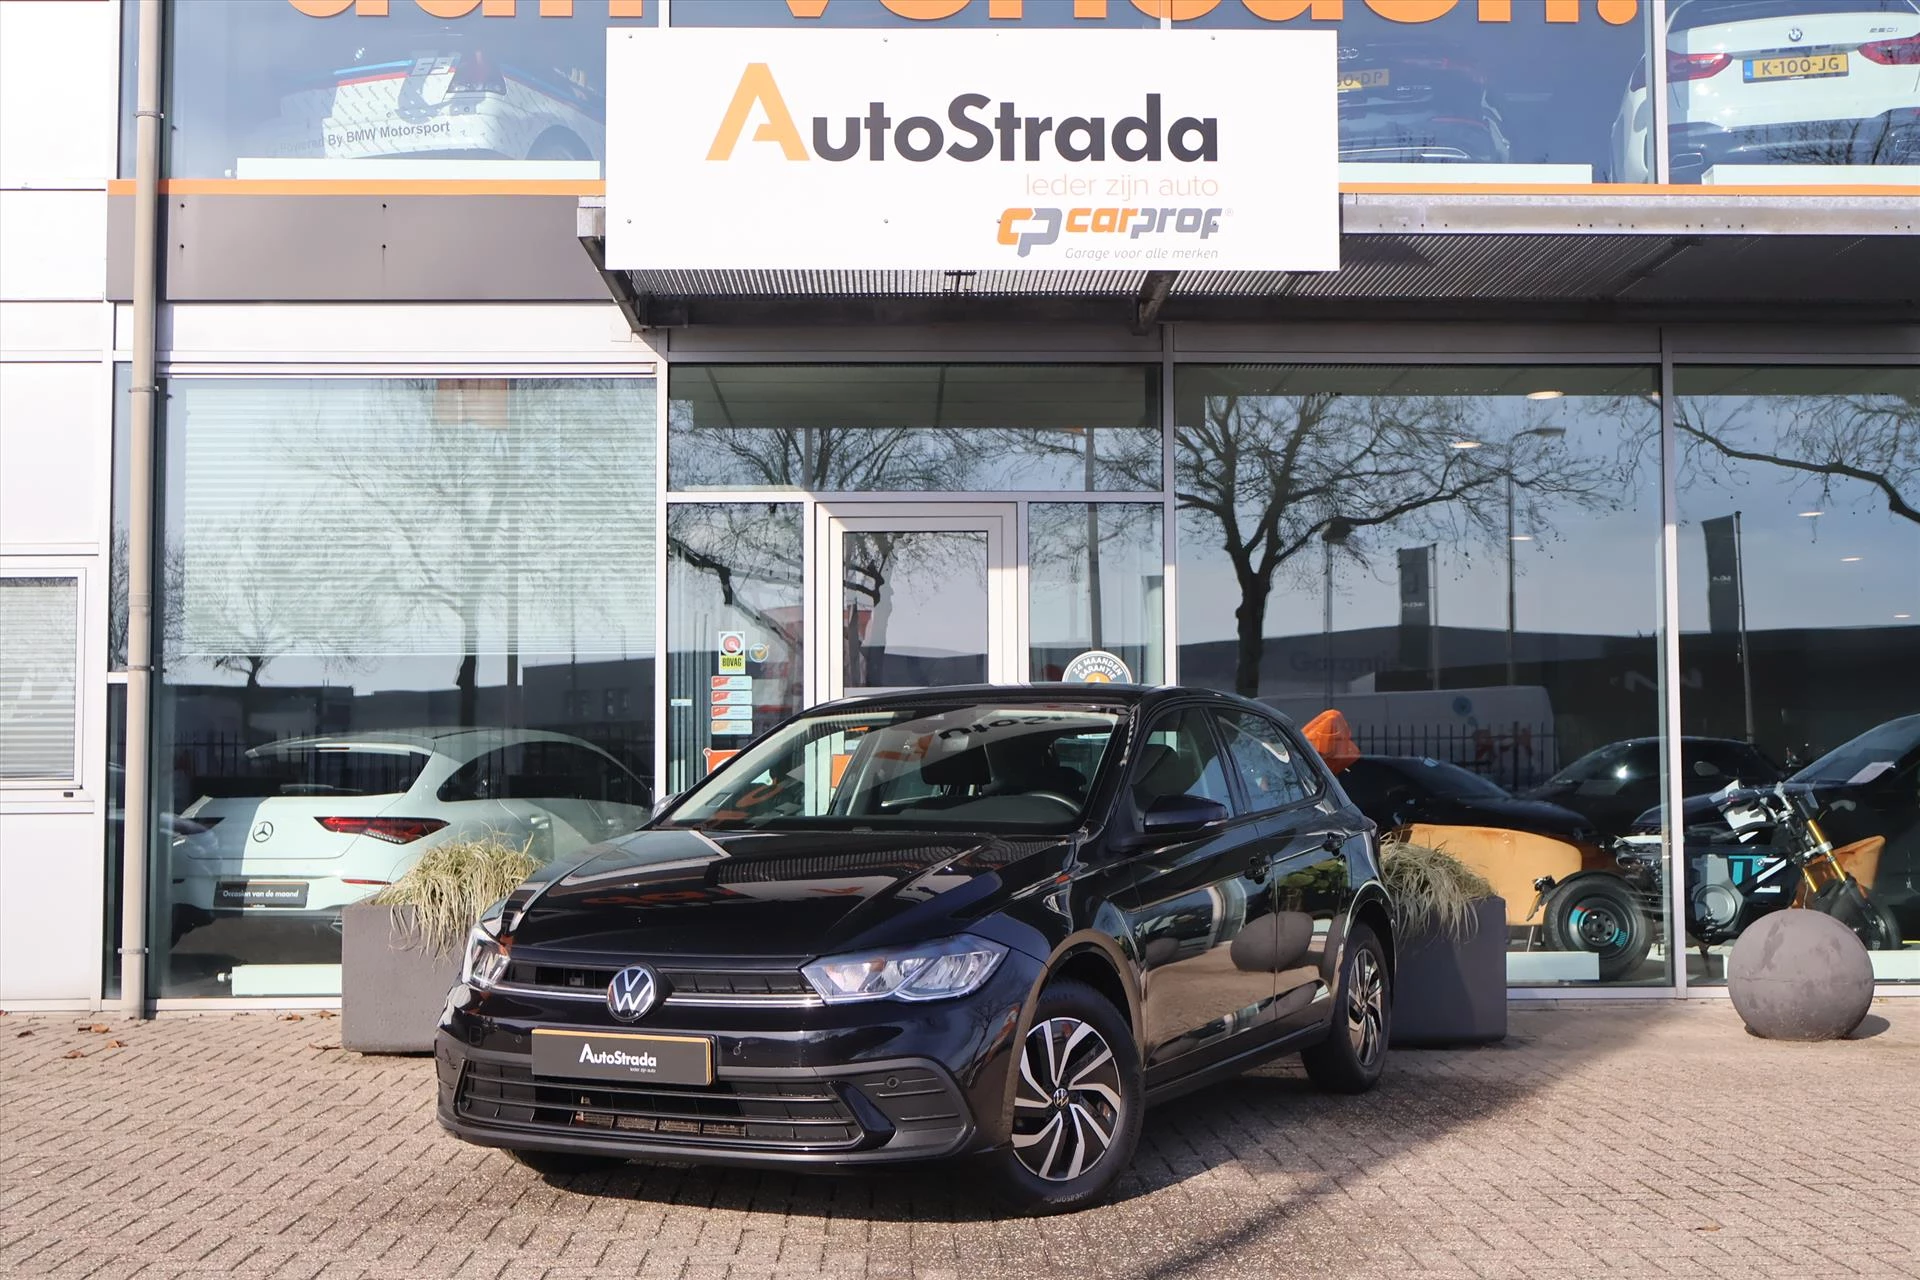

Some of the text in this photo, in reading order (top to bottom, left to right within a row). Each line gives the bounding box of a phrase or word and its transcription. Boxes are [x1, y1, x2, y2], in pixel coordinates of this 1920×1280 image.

[1761, 57, 1840, 76] K-100-JG
[705, 62, 1219, 163] AutoStrada
[327, 133, 343, 147] By
[346, 126, 377, 143] BMW
[380, 120, 451, 139] Motorsport
[1106, 174, 1149, 202] zijn
[1158, 176, 1219, 197] auto
[1065, 246, 1219, 261] Garage voor alle merken
[722, 657, 742, 667] BOVAG
[1072, 657, 1123, 677] 24 MAANDEN
[1078, 664, 1118, 681] GARANTIE
[222, 889, 300, 898] Occasion van de maand
[578, 1043, 658, 1068] AutoStrada
